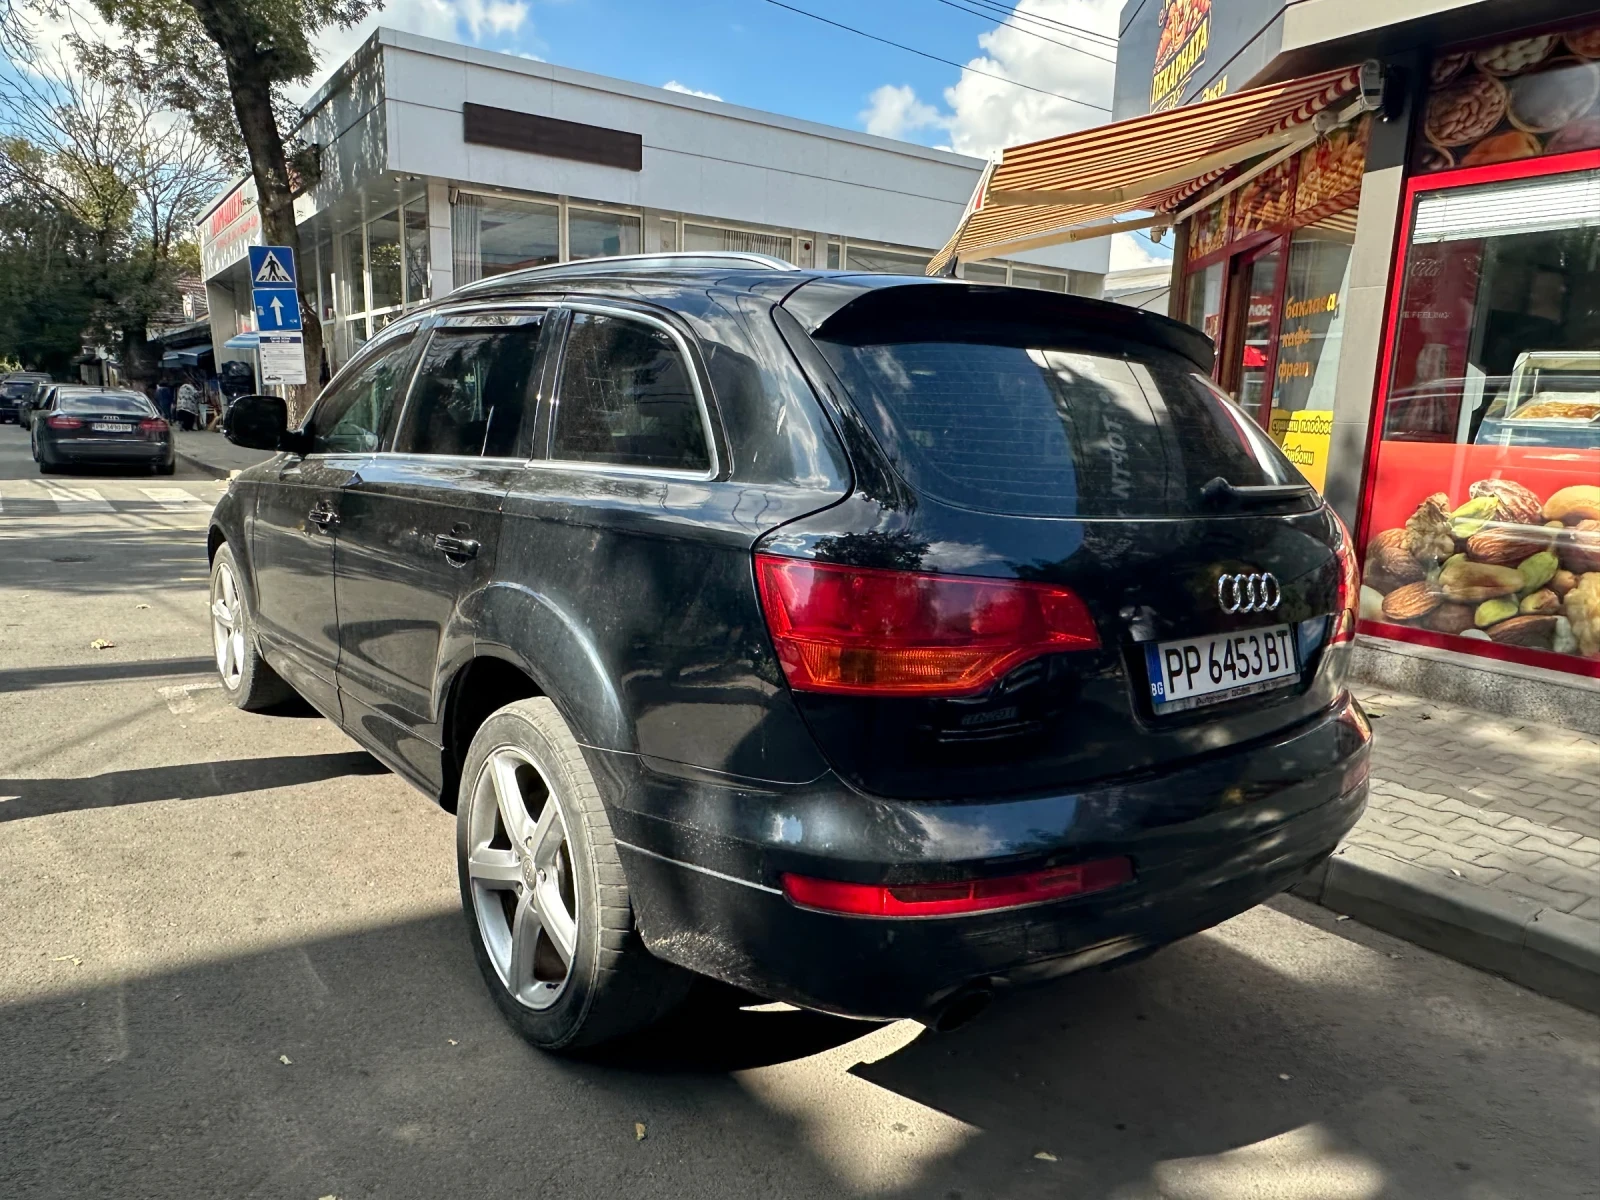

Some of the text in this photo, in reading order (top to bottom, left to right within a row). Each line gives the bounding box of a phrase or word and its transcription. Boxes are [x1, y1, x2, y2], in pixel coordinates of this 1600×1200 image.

[1151, 16, 1208, 105] ПЕКАРНАТА
[1285, 293, 1337, 319] баклава
[1282, 325, 1312, 352] кафе
[1165, 629, 1288, 694] PP 6453 BT
[1151, 682, 1164, 697] BG
